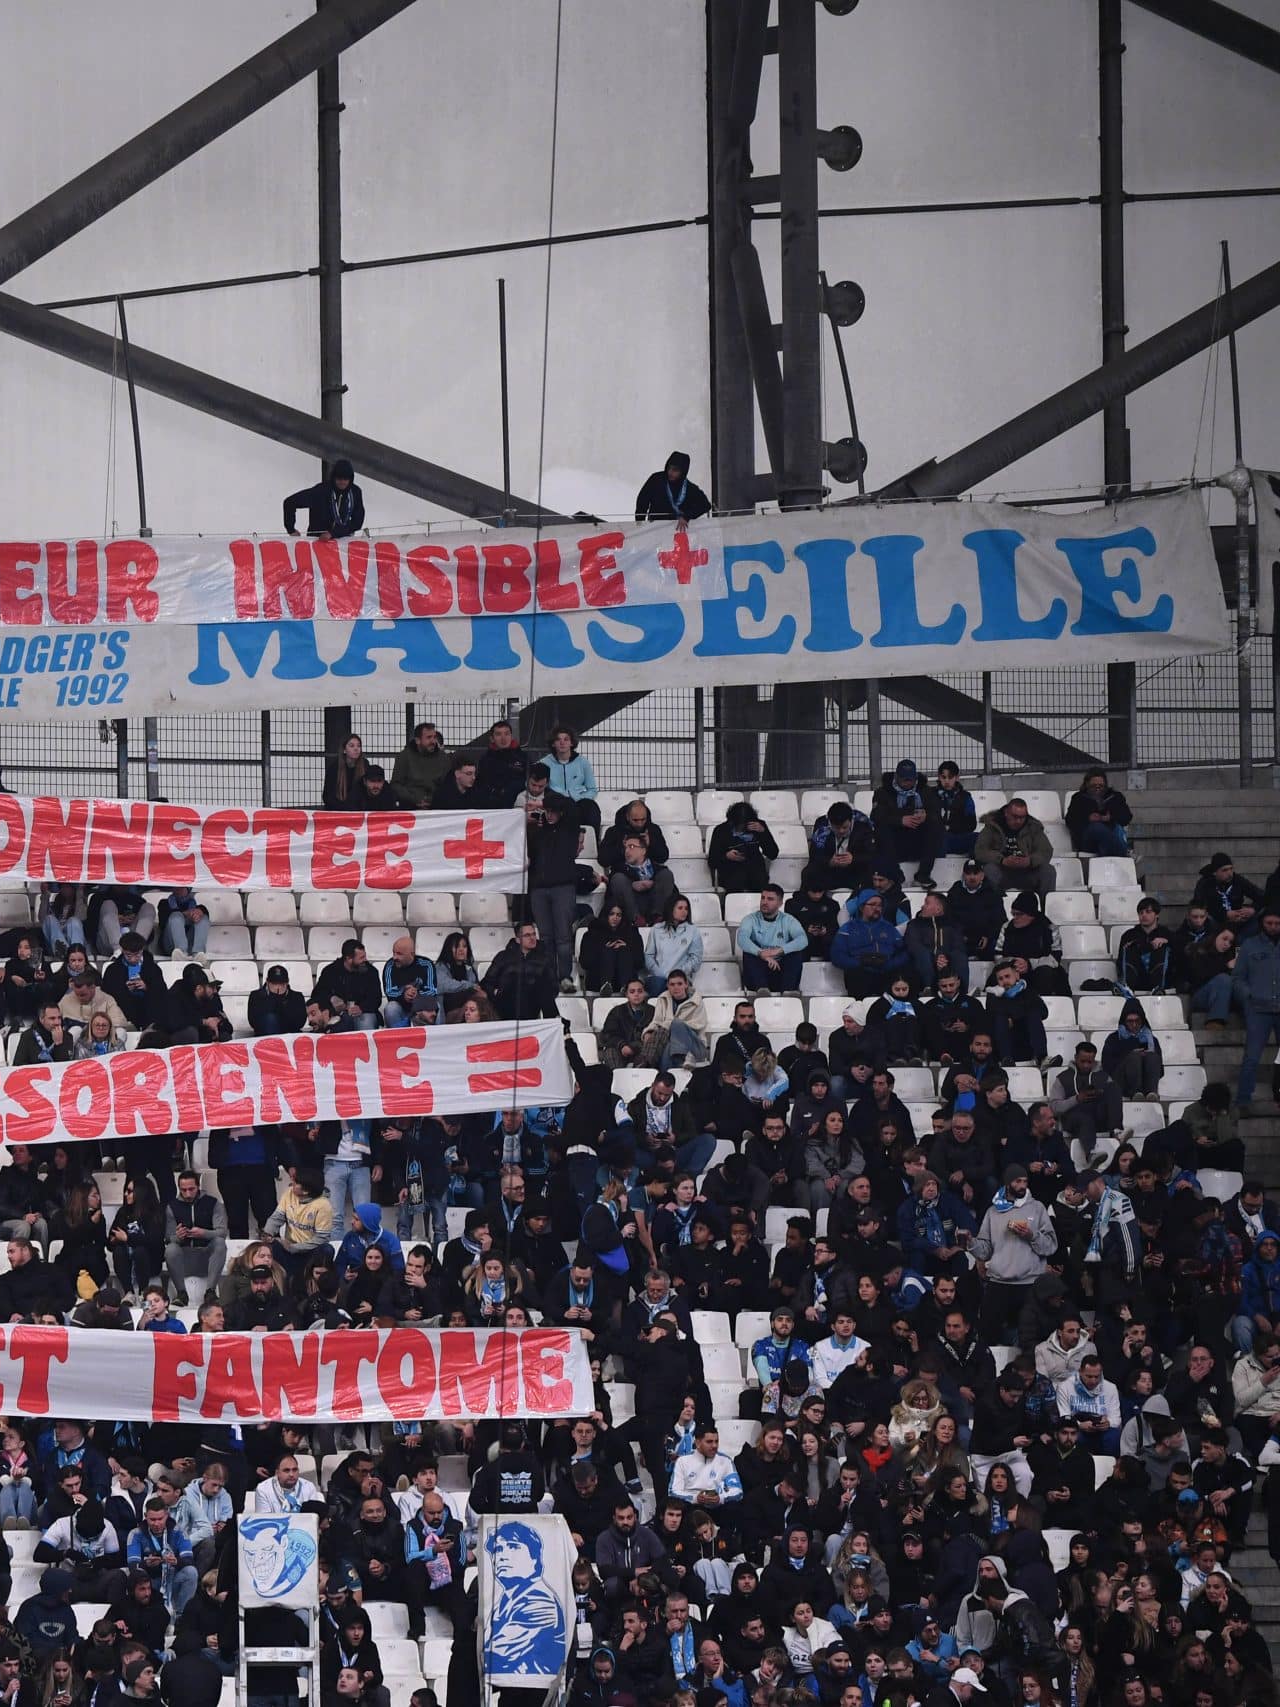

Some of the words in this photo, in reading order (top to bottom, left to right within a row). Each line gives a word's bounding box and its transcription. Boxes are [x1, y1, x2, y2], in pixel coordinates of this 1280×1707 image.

[229, 531, 627, 620] INVISIBLE
[658, 530, 709, 585] +
[56, 672, 130, 707] 1992
[443, 818, 505, 880] +
[151, 1327, 573, 1423] FANTOME
